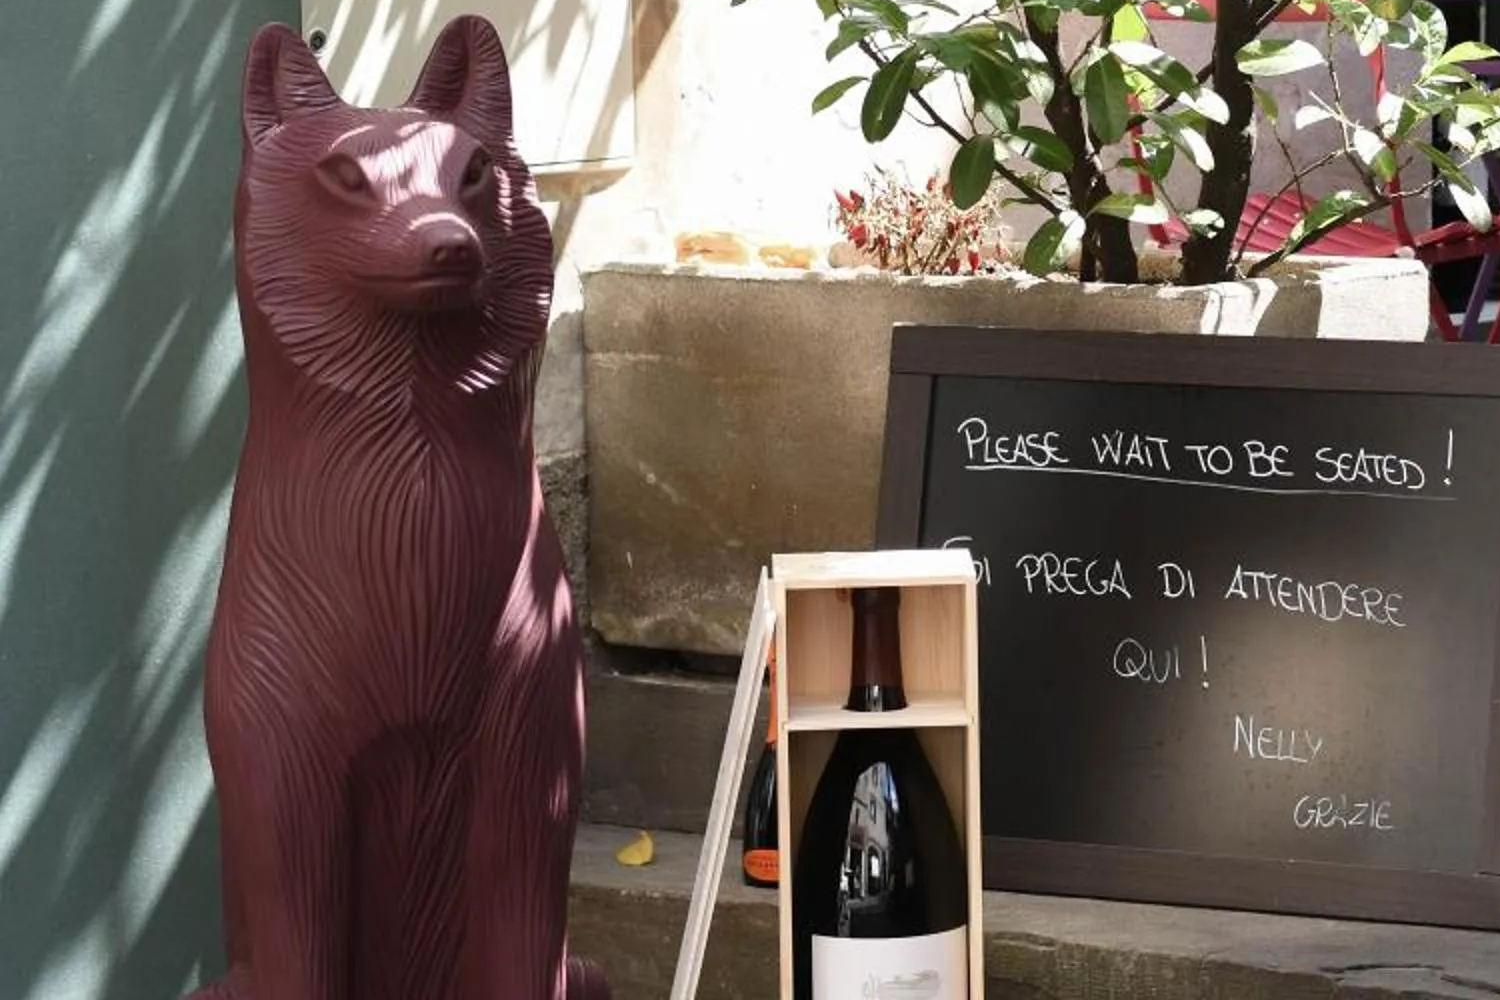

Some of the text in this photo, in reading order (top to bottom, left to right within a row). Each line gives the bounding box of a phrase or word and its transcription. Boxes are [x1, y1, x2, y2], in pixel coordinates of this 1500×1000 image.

[957, 417, 1069, 467] PLEASE
[1091, 428, 1171, 472] WAIT
[1184, 445, 1233, 475] TO
[1243, 440, 1295, 477] BE
[1016, 552, 1132, 599] PREGA
[1157, 562, 1195, 599] DI
[1225, 564, 1406, 627] ATTENDERE
[1233, 714, 1324, 764] NELLY
